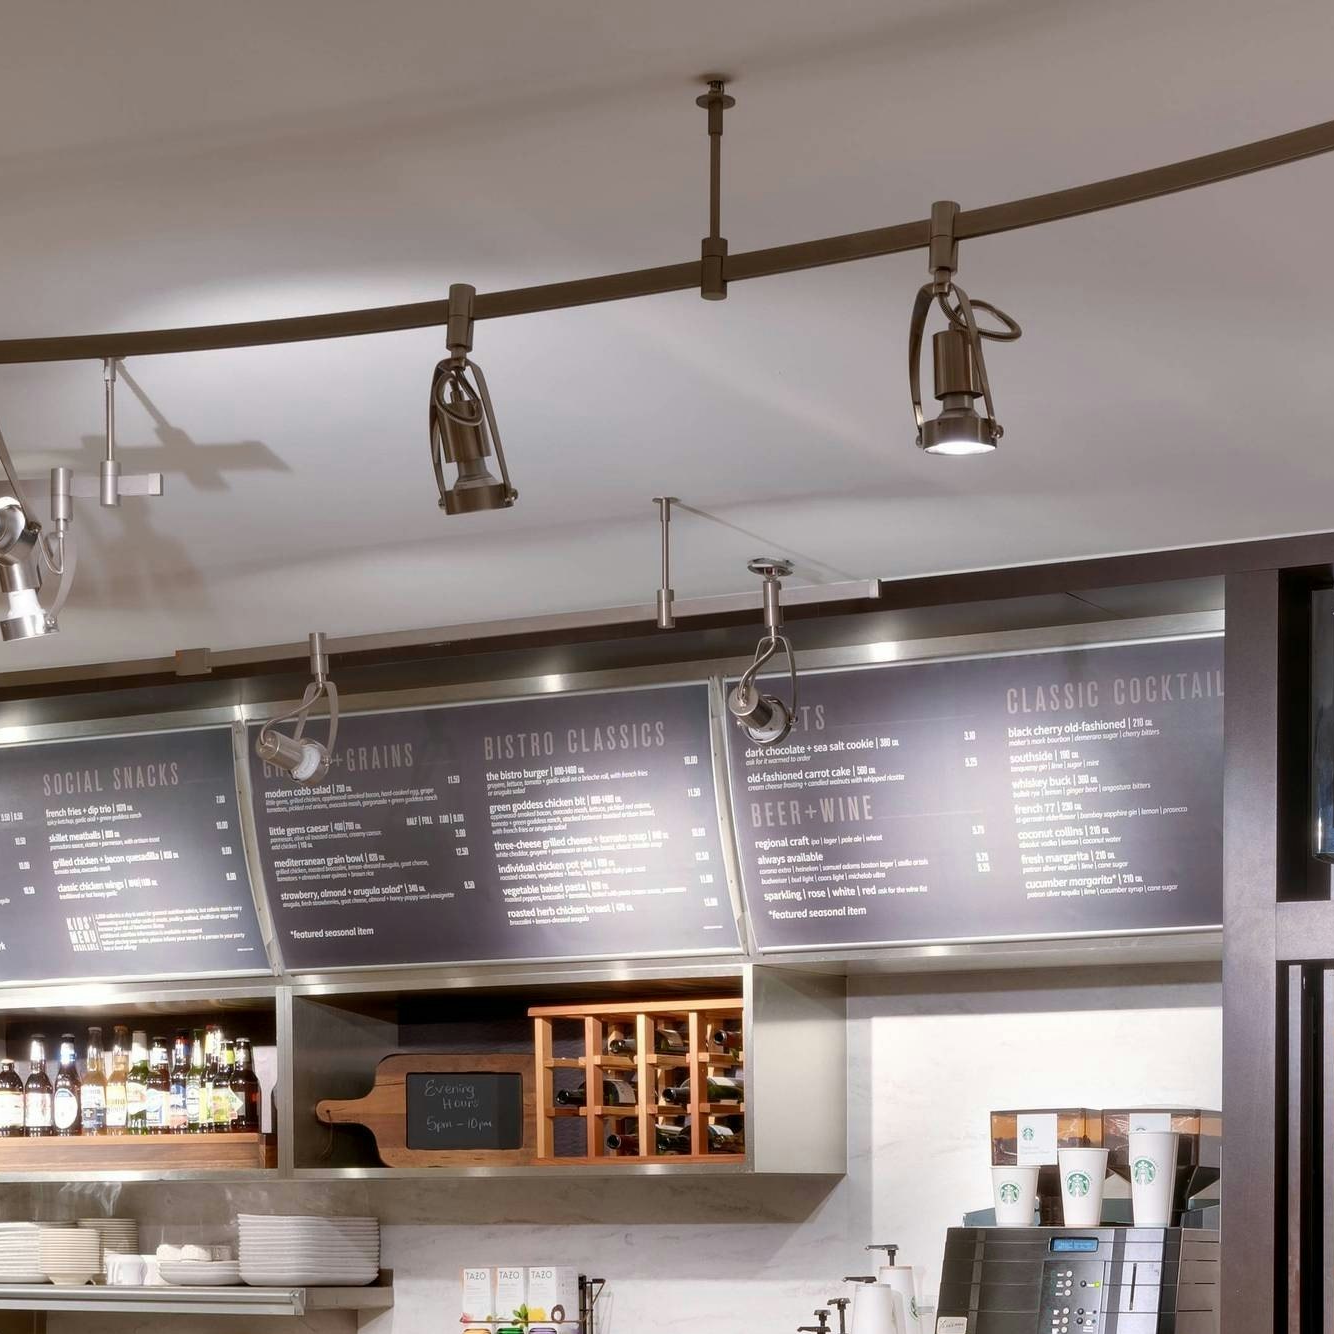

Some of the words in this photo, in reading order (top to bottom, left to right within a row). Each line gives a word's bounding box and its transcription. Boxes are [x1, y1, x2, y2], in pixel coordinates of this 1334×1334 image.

[1006, 680, 1099, 714] CLASSIC
[1008, 726, 1032, 737] black
[1033, 725, 1063, 736] cherry
[1064, 718, 1126, 733] old-fashioned
[484, 731, 554, 761] BISTRO
[568, 721, 665, 754] CLASSICS
[746, 747, 764, 758] dark
[766, 745, 805, 756] chocolate
[814, 745, 828, 753] sea
[829, 741, 845, 751] salt
[846, 739, 874, 749] cookie
[1010, 751, 1053, 763] southside
[43, 769, 103, 797] SOCIAL
[114, 762, 179, 791] SNACKS
[486, 771, 499, 781] the
[500, 769, 522, 780] bistro
[523, 768, 549, 779] burger
[747, 770, 803, 783] old-fashioned
[805, 768, 830, 779] carrot
[832, 766, 851, 777] cake
[1011, 777, 1047, 790] whiskey
[1050, 775, 1071, 785] buck
[265, 788, 292, 799] modern
[293, 786, 311, 796] cobb
[311, 784, 331, 795] salad
[46, 808, 66, 818] french
[67, 808, 82, 817] fries
[88, 806, 99, 816] dip
[100, 805, 111, 814] trio
[490, 804, 511, 814] green
[512, 800, 544, 812] goddess
[545, 798, 574, 808] chicken
[1014, 803, 1043, 815] french
[1044, 803, 1055, 812] 77
[269, 826, 286, 836] little
[287, 826, 305, 837] gems
[306, 824, 330, 833] caesar
[1018, 830, 1054, 840] coconut
[1055, 827, 1084, 837] collins
[49, 833, 68, 843] skillet
[494, 840, 542, 851] three-cheese
[542, 838, 566, 850] grilled
[755, 837, 788, 850] regional
[790, 836, 810, 848] craft
[274, 856, 326, 867] mediterranean
[327, 855, 345, 866] grain
[346, 853, 364, 863] bowl
[758, 854, 786, 865] always
[787, 852, 823, 863] available
[1021, 853, 1044, 864] fresh
[1045, 852, 1089, 864] margarita
[498, 862, 536, 874] individual
[536, 861, 565, 872] chicken
[503, 884, 539, 897] vegetable
[540, 883, 564, 893] baked
[565, 882, 587, 893] pasta
[1026, 878, 1068, 889] cucumber
[281, 890, 319, 901] strawberry,
[320, 888, 347, 898] almond
[353, 886, 380, 897] arugula
[764, 889, 801, 902] sparkling
[808, 889, 826, 898] rose
[832, 886, 856, 897] white
[862, 885, 876, 895] red
[508, 907, 536, 918] roasted
[537, 905, 555, 916] herb
[556, 904, 585, 915] chicken
[586, 902, 611, 913] breast
[809, 906, 847, 918] seasonal
[847, 906, 867, 916] item
[70, 930, 96, 945] MENU
[325, 926, 357, 937] seasonal
[358, 927, 374, 936] item
[424, 1079, 475, 1099] Evening
[442, 1098, 479, 1110] Hours
[427, 1116, 452, 1133] 5pm
[467, 1117, 492, 1132] 10pm
[466, 1272, 486, 1281] TAZO
[499, 1271, 520, 1279] TAZO
[531, 1271, 553, 1279] TAZO
